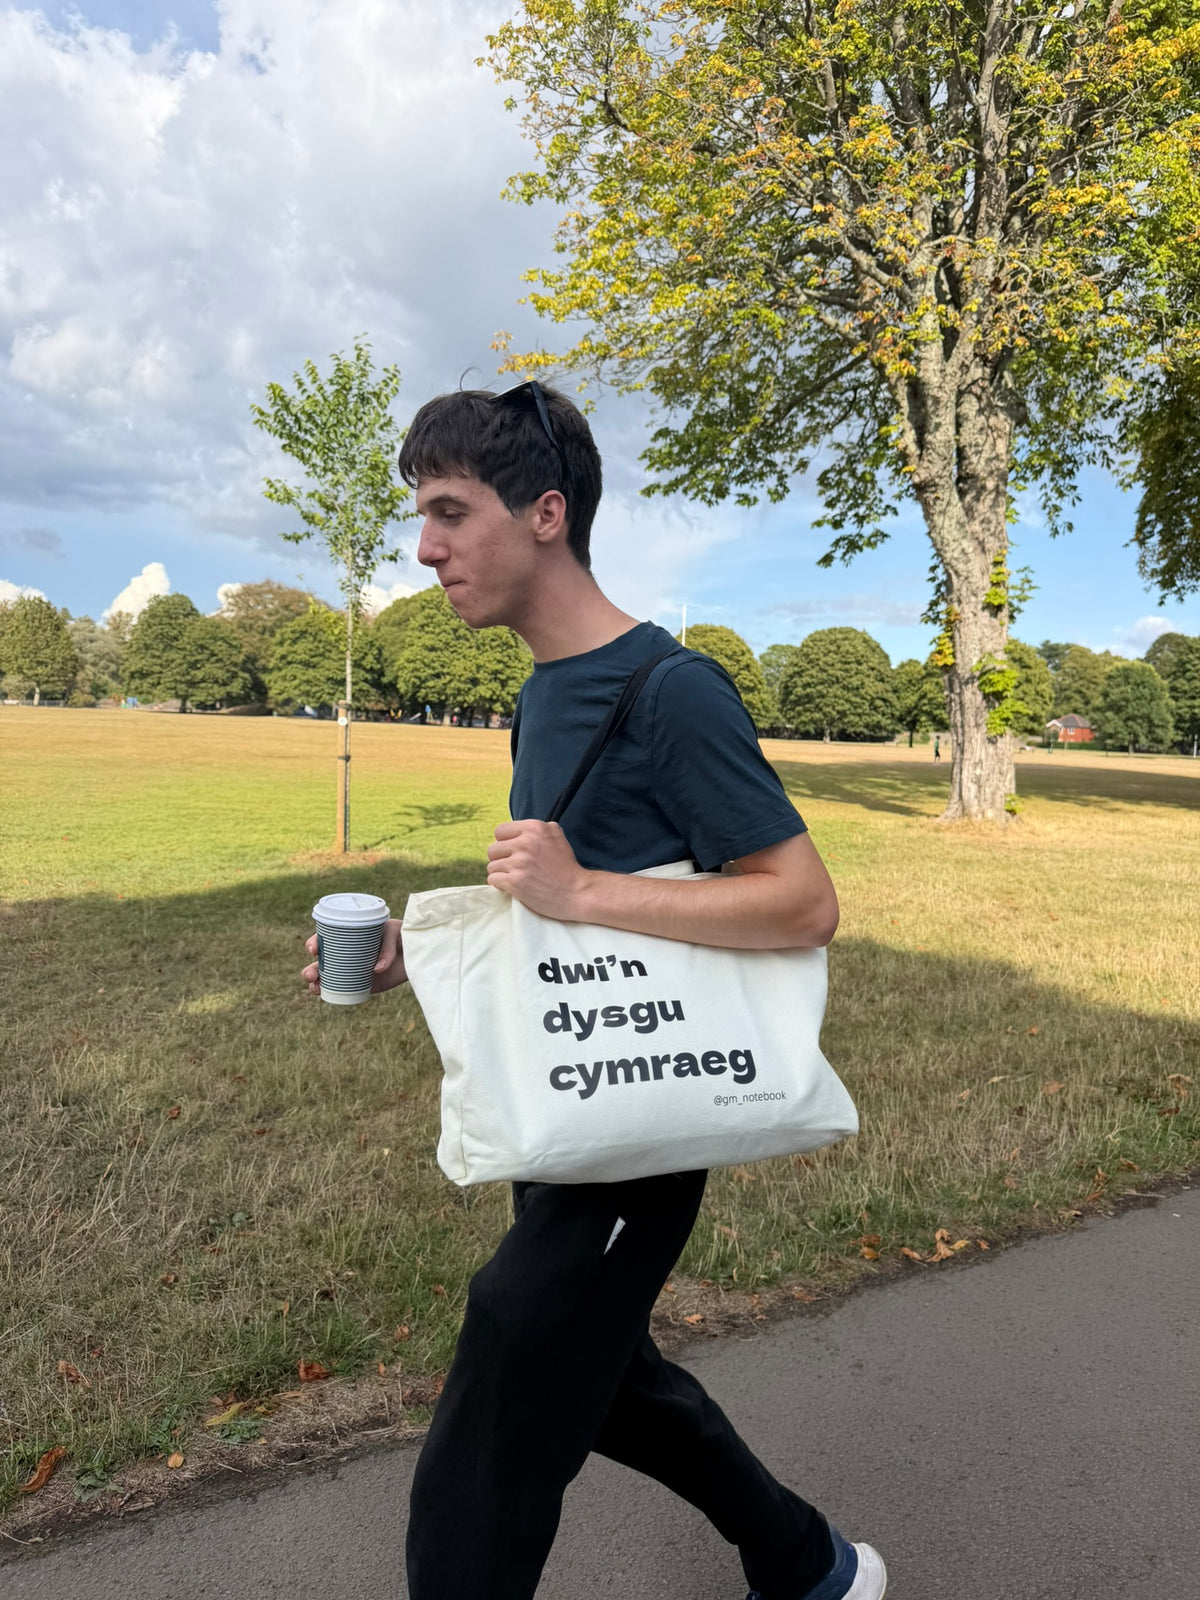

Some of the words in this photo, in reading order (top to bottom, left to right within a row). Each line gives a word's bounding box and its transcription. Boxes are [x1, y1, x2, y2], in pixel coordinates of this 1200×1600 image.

[543, 1000, 686, 1042] dysgu
[549, 1049, 757, 1100] cymraeg
[713, 1090, 787, 1106] @gm_notebook
